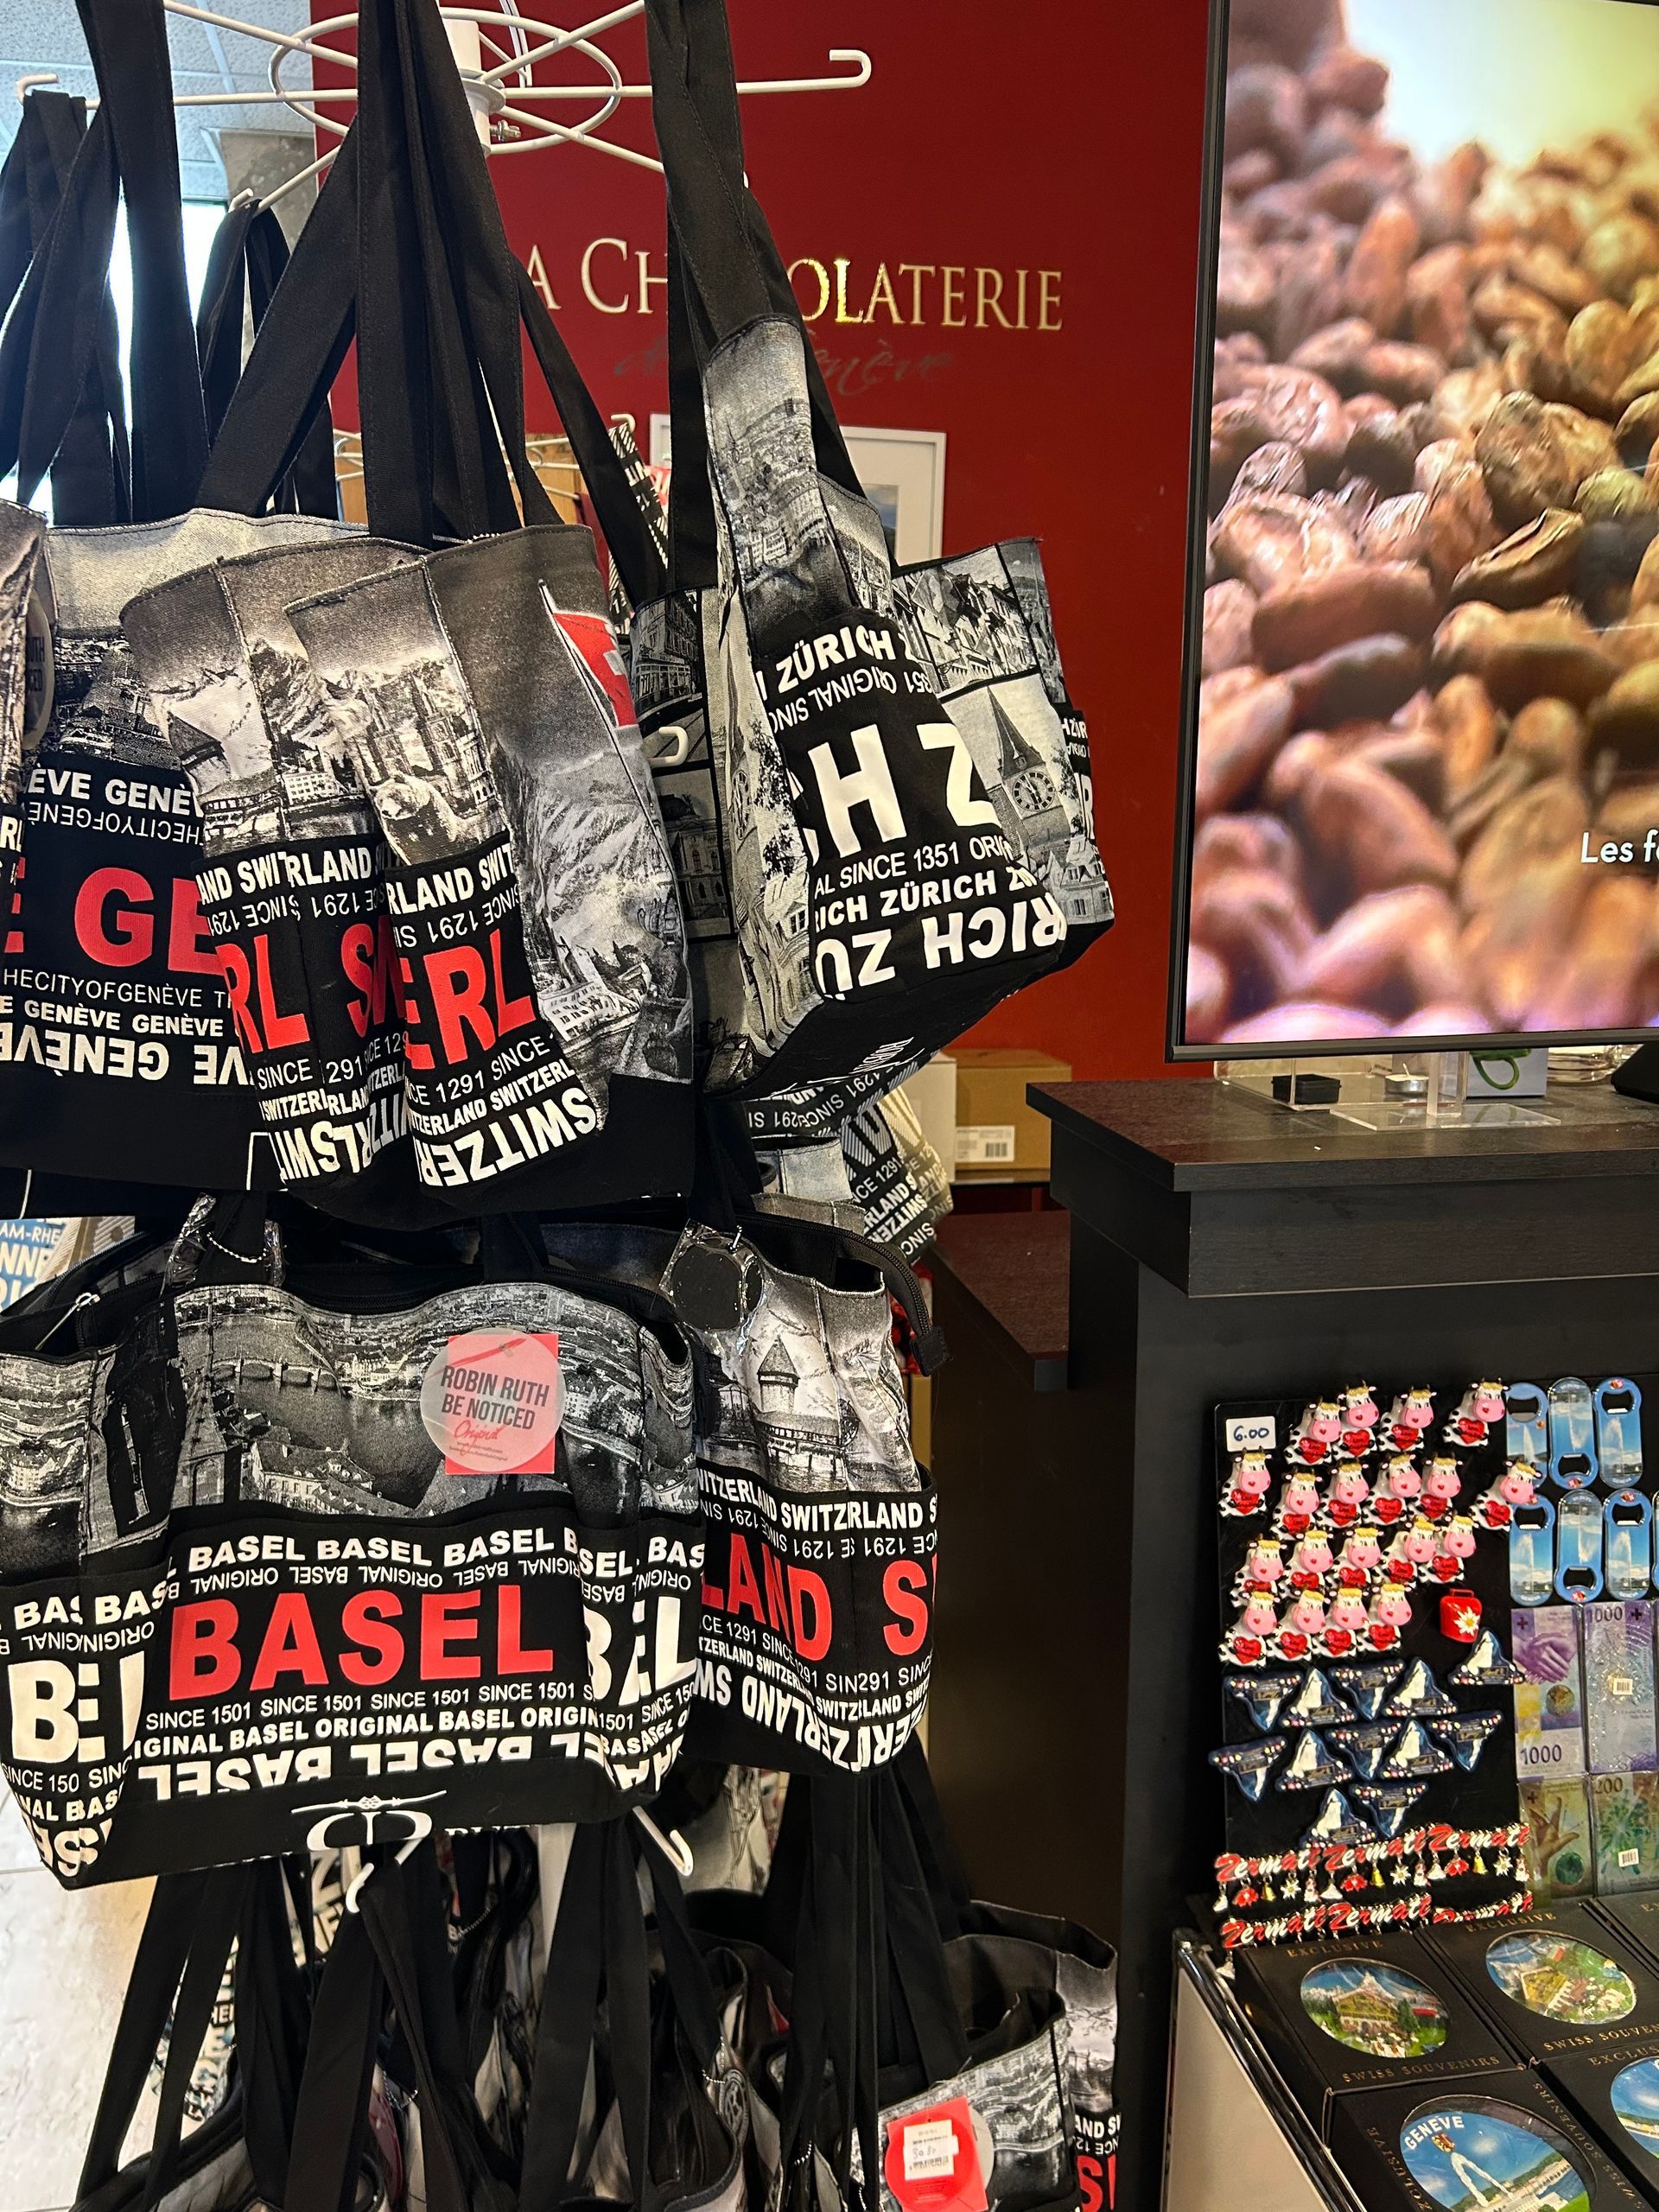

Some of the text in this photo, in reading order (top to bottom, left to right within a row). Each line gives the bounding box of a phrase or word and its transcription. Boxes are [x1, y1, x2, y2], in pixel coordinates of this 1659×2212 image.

[776, 625, 896, 694] ZÜRICH
[1580, 829, 1659, 863] Les f
[840, 851, 907, 888] SINCE
[912, 841, 959, 872] 1351
[815, 893, 868, 934] ICH
[880, 868, 996, 918] ZÜRICH
[428, 910, 479, 944] 1291
[24, 999, 121, 1031] GENÈVE
[131, 1013, 224, 1037] GENÈVE
[194, 1045, 255, 1086] VE
[257, 1056, 363, 1090] SINCE 291
[435, 1070, 485, 1103] 1291
[491, 1036, 550, 1081] SINCE
[413, 1087, 598, 1187] SWITZER
[440, 1364, 550, 1408] ROBIN RUTH
[442, 1393, 536, 1430] BE NOTICED
[1233, 1426, 1269, 1442] 6.00
[188, 1535, 306, 1572] BASEL
[317, 1537, 433, 1567] BASEL
[443, 1527, 555, 1567] BASEL
[793, 1538, 835, 1560] 1291
[863, 1536, 906, 1557] 1291
[189, 1566, 279, 1595] ORIGINAL
[289, 1565, 348, 1585] BASEL
[358, 1565, 443, 1588] ORIGINAL
[454, 1560, 509, 1587] BASEL
[169, 1585, 554, 1700] BASEL
[727, 1621, 757, 1646] 1291
[146, 1708, 206, 1731] SINCE
[212, 1702, 251, 1725] 1501
[260, 1694, 317, 1718] SINCE
[323, 1694, 362, 1712] 1501
[370, 1691, 427, 1710] SINCE
[432, 1688, 470, 1706] 1501
[478, 1683, 533, 1703] SINCE
[538, 1681, 575, 1700] 1501
[599, 1713, 634, 1732] 1501
[135, 1733, 223, 1759] IGINAL
[230, 1720, 309, 1751] BASEL
[315, 1712, 434, 1738] ORIGINAL
[439, 1707, 515, 1731] BASEL
[1520, 1744, 1562, 1765] 1000
[1214, 1823, 1531, 1883] Zermatt Zermatt Zermatt
[1221, 1906, 1325, 1948] Zermatt
[1326, 1894, 1432, 1933] Zermatt
[1465, 1912, 1556, 1933] EXCLUSIVE
[1287, 1942, 1382, 1958] EXCLUSIVE
[1543, 2032, 1594, 2051] SWISS
[1342, 2055, 1500, 2083] SWISS SOUVENIRS
